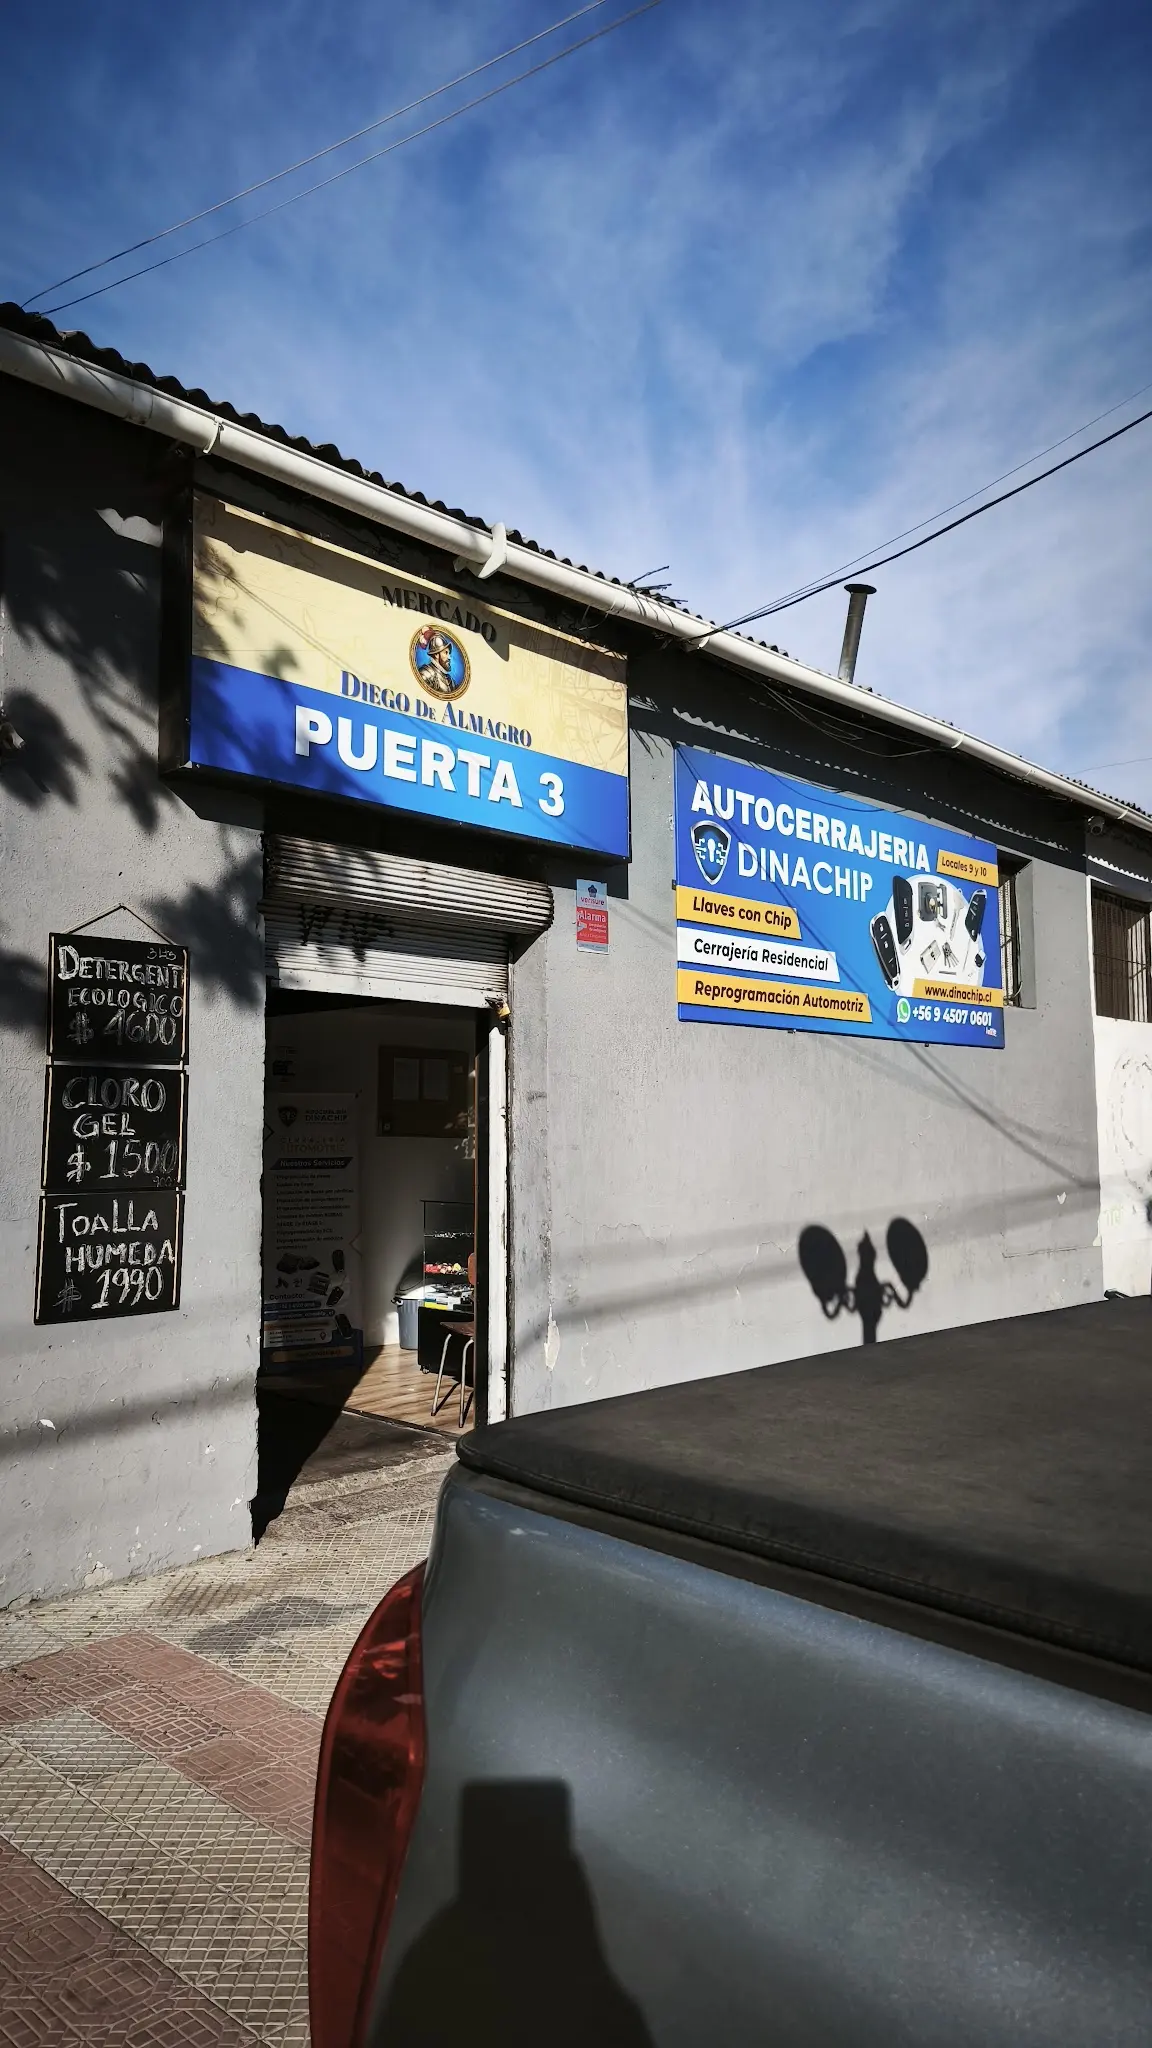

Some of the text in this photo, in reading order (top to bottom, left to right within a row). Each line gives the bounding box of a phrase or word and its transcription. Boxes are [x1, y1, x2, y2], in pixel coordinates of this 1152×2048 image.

[381, 585, 497, 644] MERCADO
[340, 669, 410, 712] DIEGO
[441, 701, 532, 747] ALMAGRO
[295, 704, 565, 817] PUERTA 3
[691, 779, 931, 872] AUTOCERRAJERIA
[737, 842, 873, 902] DINACHIP
[941, 856, 987, 877] Locales 9 y 10
[579, 910, 606, 923] Alarma
[693, 896, 792, 930] Llaves con Chip
[147, 947, 157, 960] 3
[694, 938, 828, 972] Cerrajería Residencial
[694, 980, 864, 1013] Reprogramación Automotriz
[924, 986, 992, 1004] www.dinachip.cl
[103, 1008, 177, 1045] 4600
[912, 1005, 992, 1026] +56 9 4507 0601
[62, 1076, 167, 1112] CLORO
[72, 1111, 136, 1139] GEL
[305, 1114, 348, 1122] DINACHIP
[99, 1139, 178, 1179] 1500
[65, 1239, 175, 1273] HUMEDA
[91, 1266, 164, 1310] 1990
